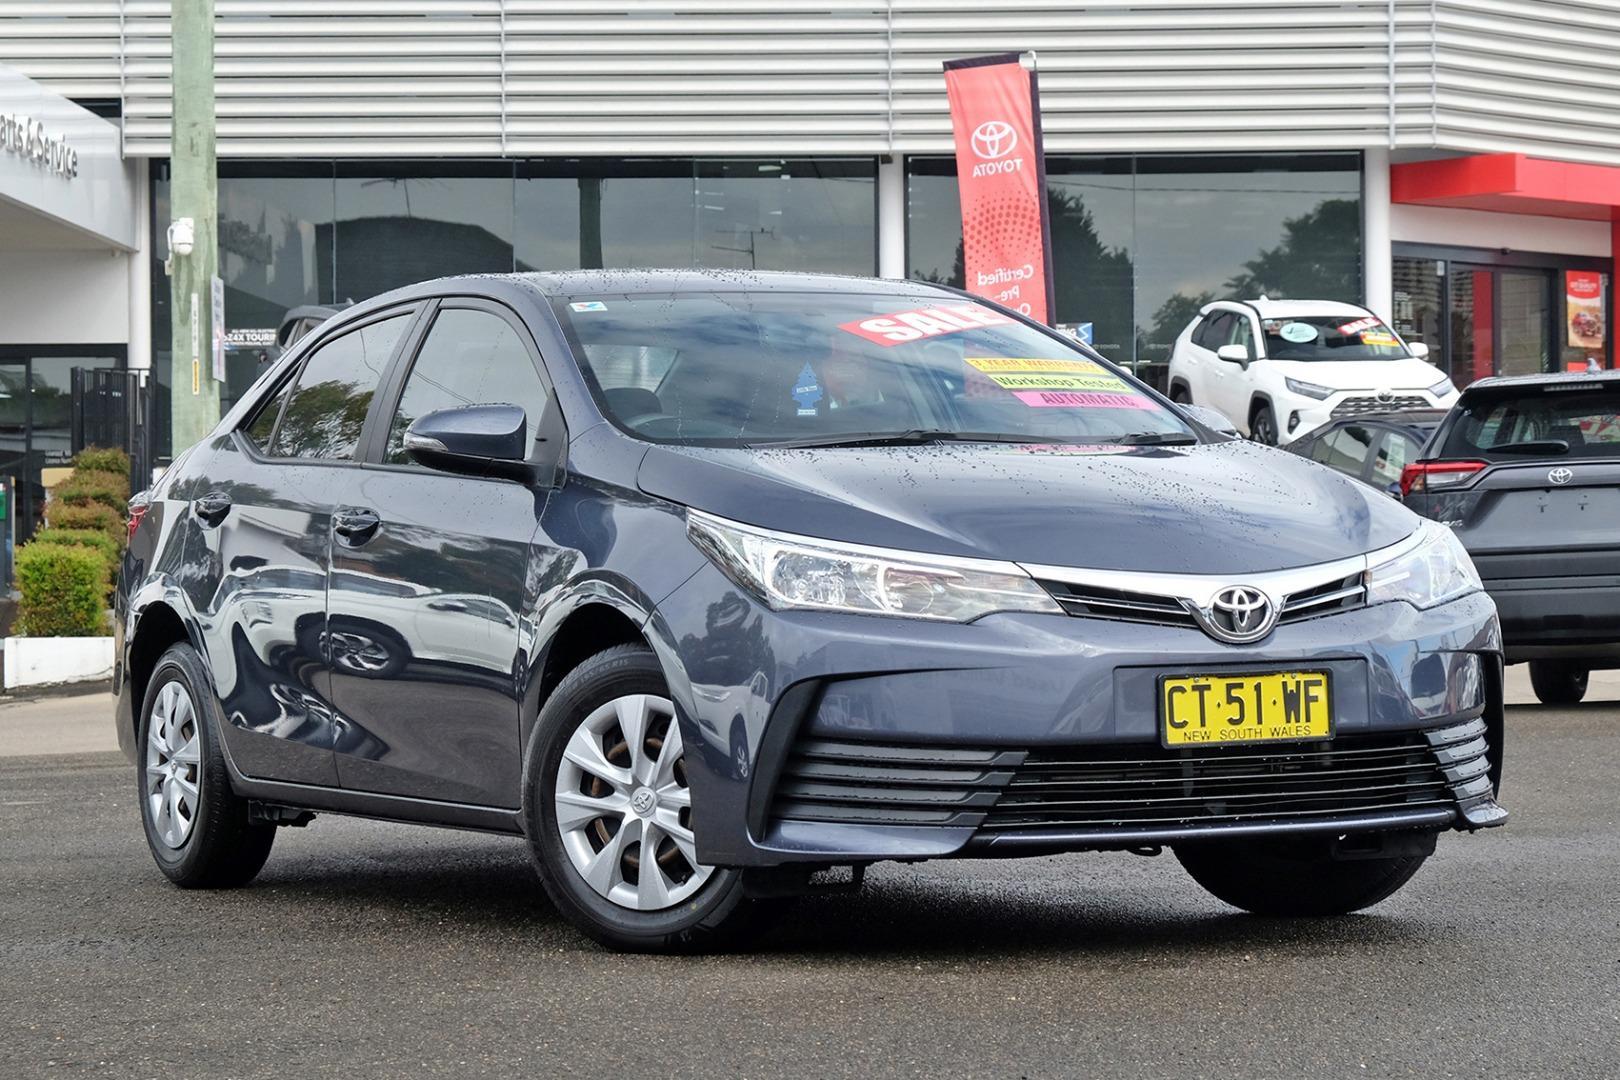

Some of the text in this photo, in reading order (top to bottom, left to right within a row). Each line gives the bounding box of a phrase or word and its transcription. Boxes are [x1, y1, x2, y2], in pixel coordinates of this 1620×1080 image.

[37, 121, 78, 178] Service
[859, 303, 1009, 341] SALE
[984, 358, 1022, 368] YEAR
[994, 375, 1127, 391] Workshop Tested
[1040, 392, 1137, 408] AUTOMATIC
[1183, 725, 1312, 742] NEW SOUTH WALES
